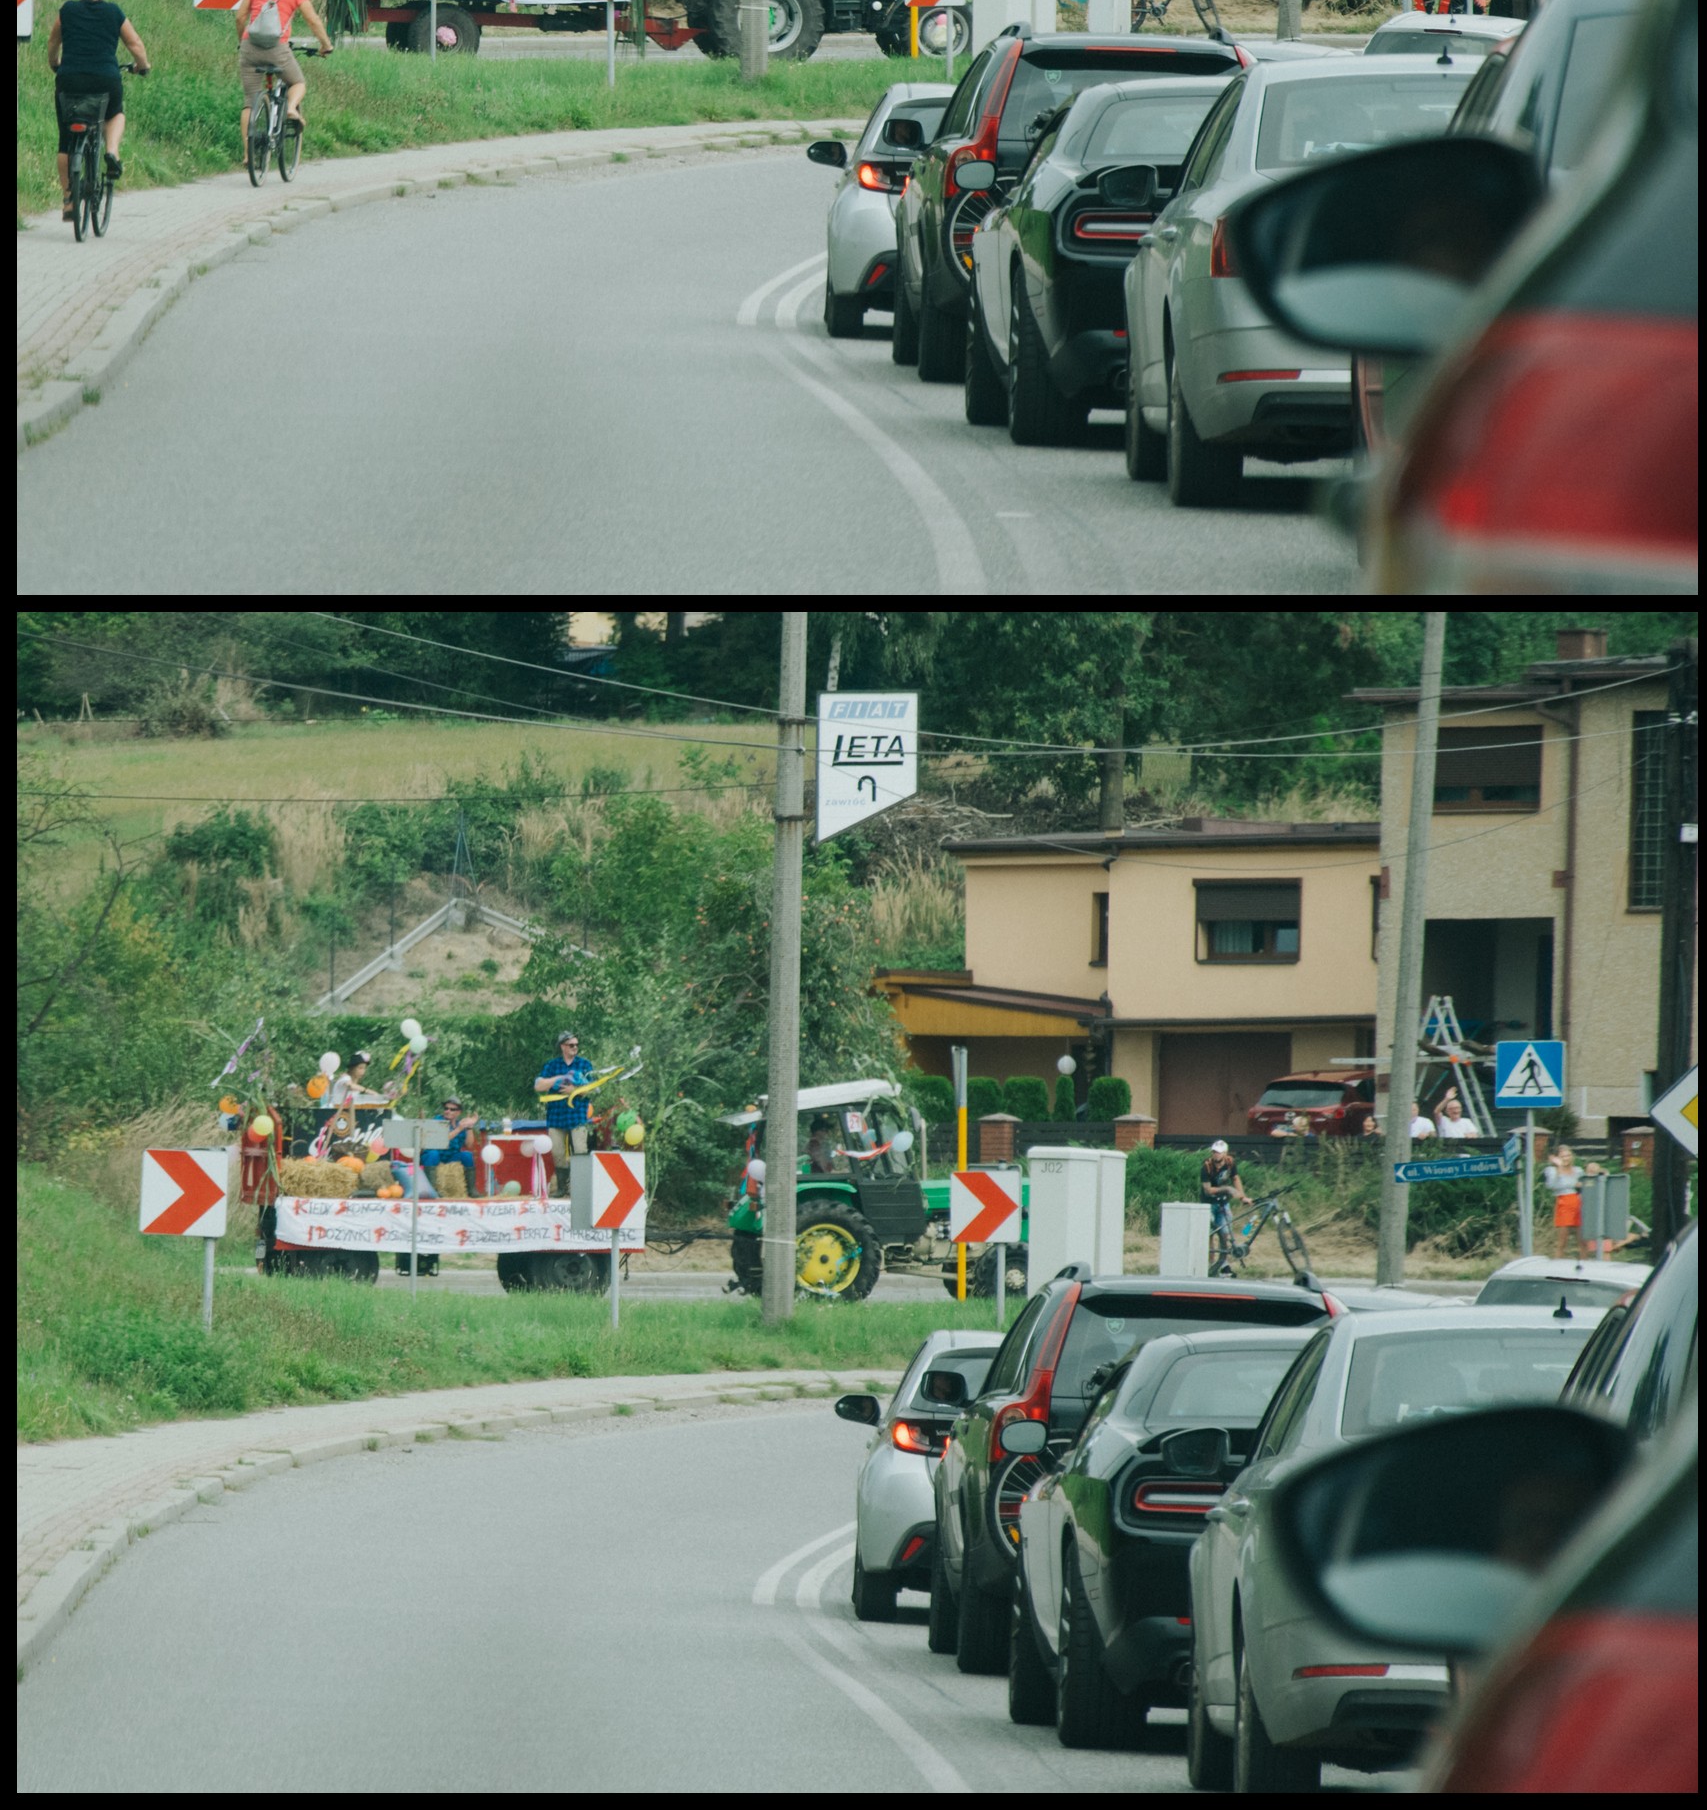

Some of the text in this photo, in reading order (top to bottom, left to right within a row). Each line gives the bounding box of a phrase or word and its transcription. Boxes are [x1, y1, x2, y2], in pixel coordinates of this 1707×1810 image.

[828, 701, 909, 719] FIAT
[832, 735, 905, 767] LETA
[1407, 1169, 1421, 1177] ul.
[1422, 1164, 1459, 1177] Wiosny
